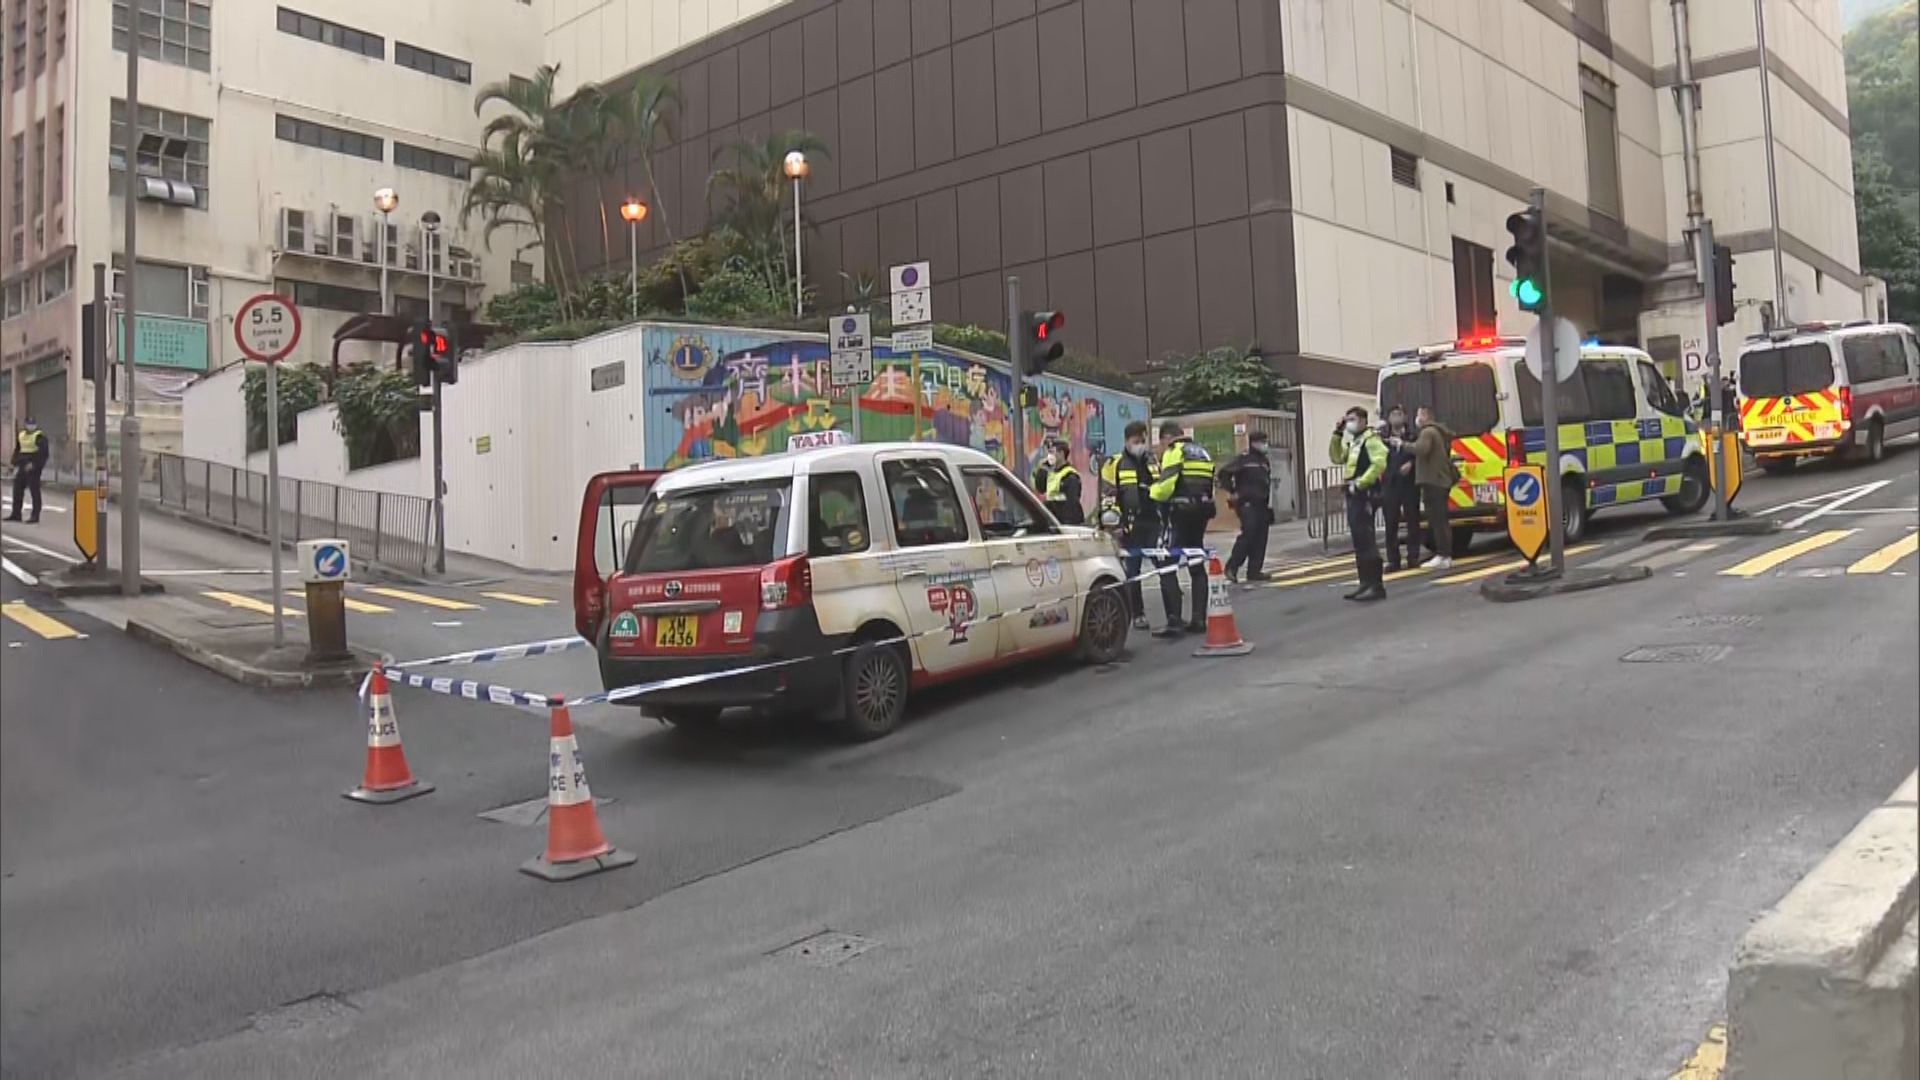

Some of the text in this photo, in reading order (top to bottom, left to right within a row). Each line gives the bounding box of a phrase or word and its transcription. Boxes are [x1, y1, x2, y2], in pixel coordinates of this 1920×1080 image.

[252, 306, 282, 324] 5.5
[857, 370, 869, 381] 12
[1770, 412, 1806, 424] POLICE
[791, 432, 834, 449] TAXI
[659, 631, 694, 646] 4436
